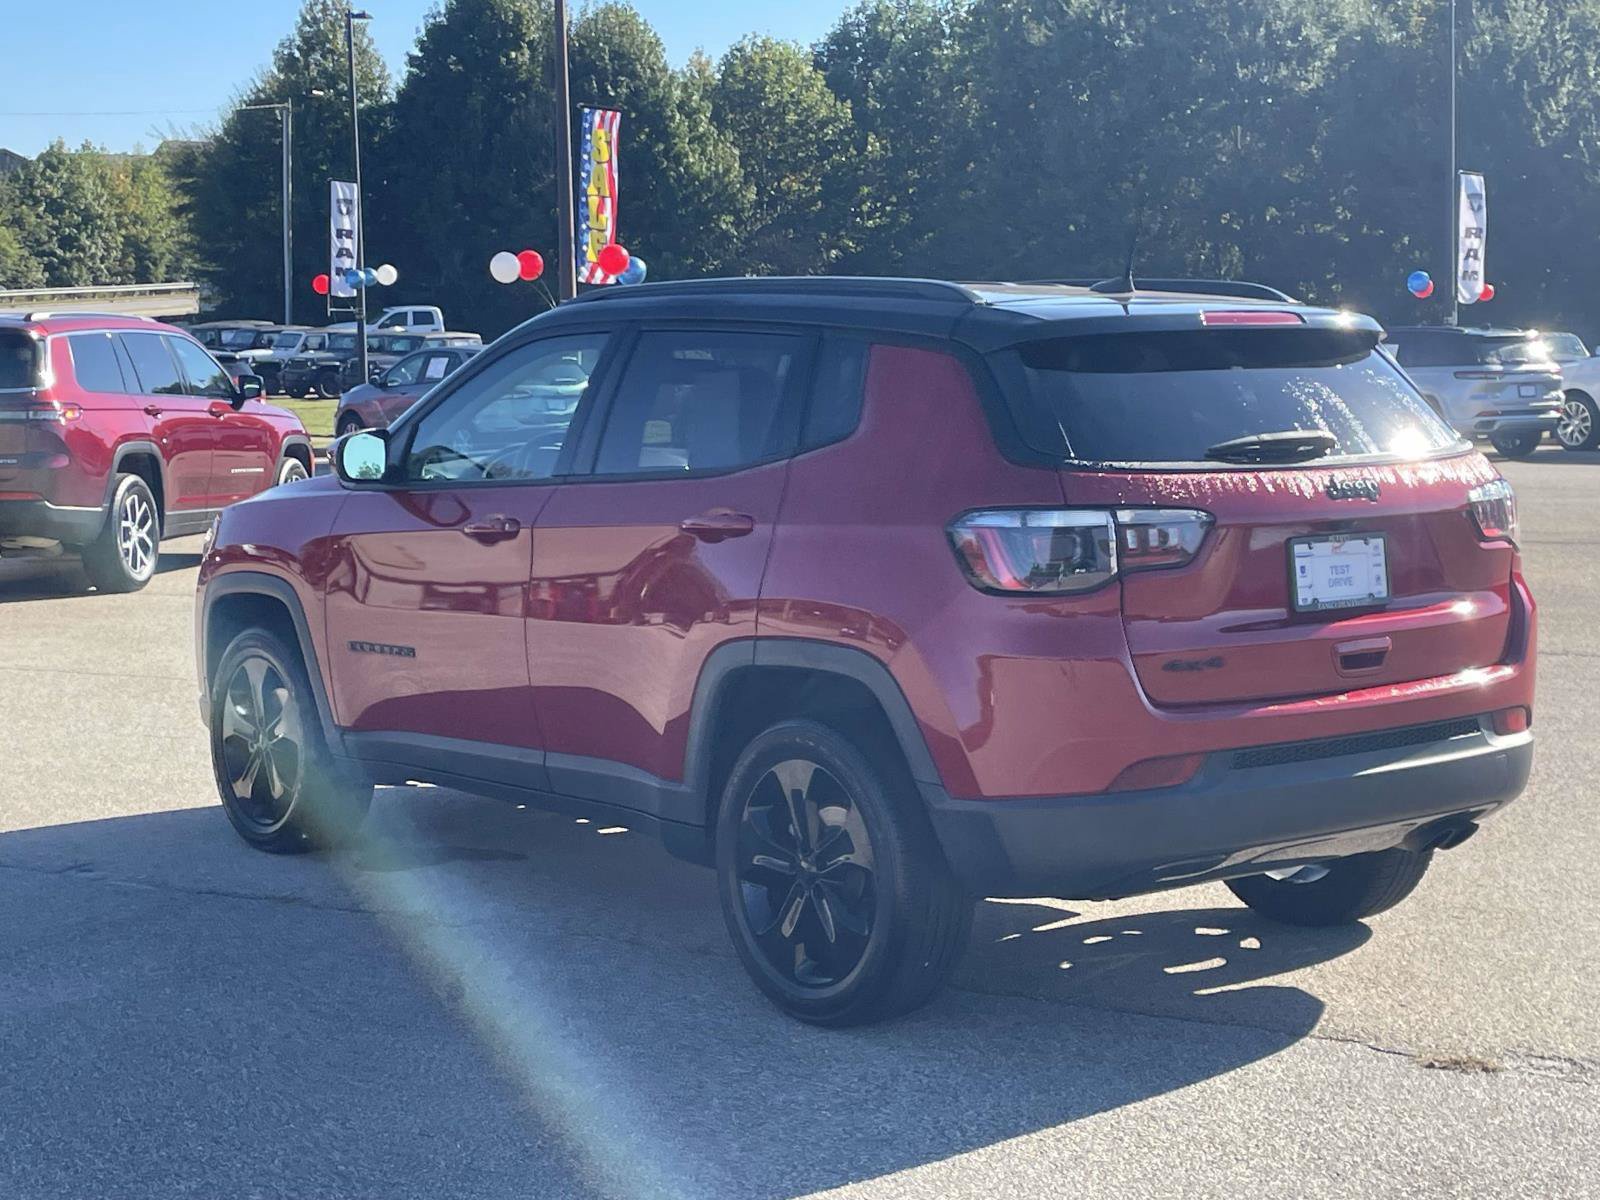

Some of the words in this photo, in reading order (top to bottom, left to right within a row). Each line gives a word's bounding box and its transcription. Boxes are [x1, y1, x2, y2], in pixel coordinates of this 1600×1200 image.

[587, 128, 612, 263] SALE
[1329, 564, 1351, 576] TEST
[1328, 576, 1354, 588] DRIVE
